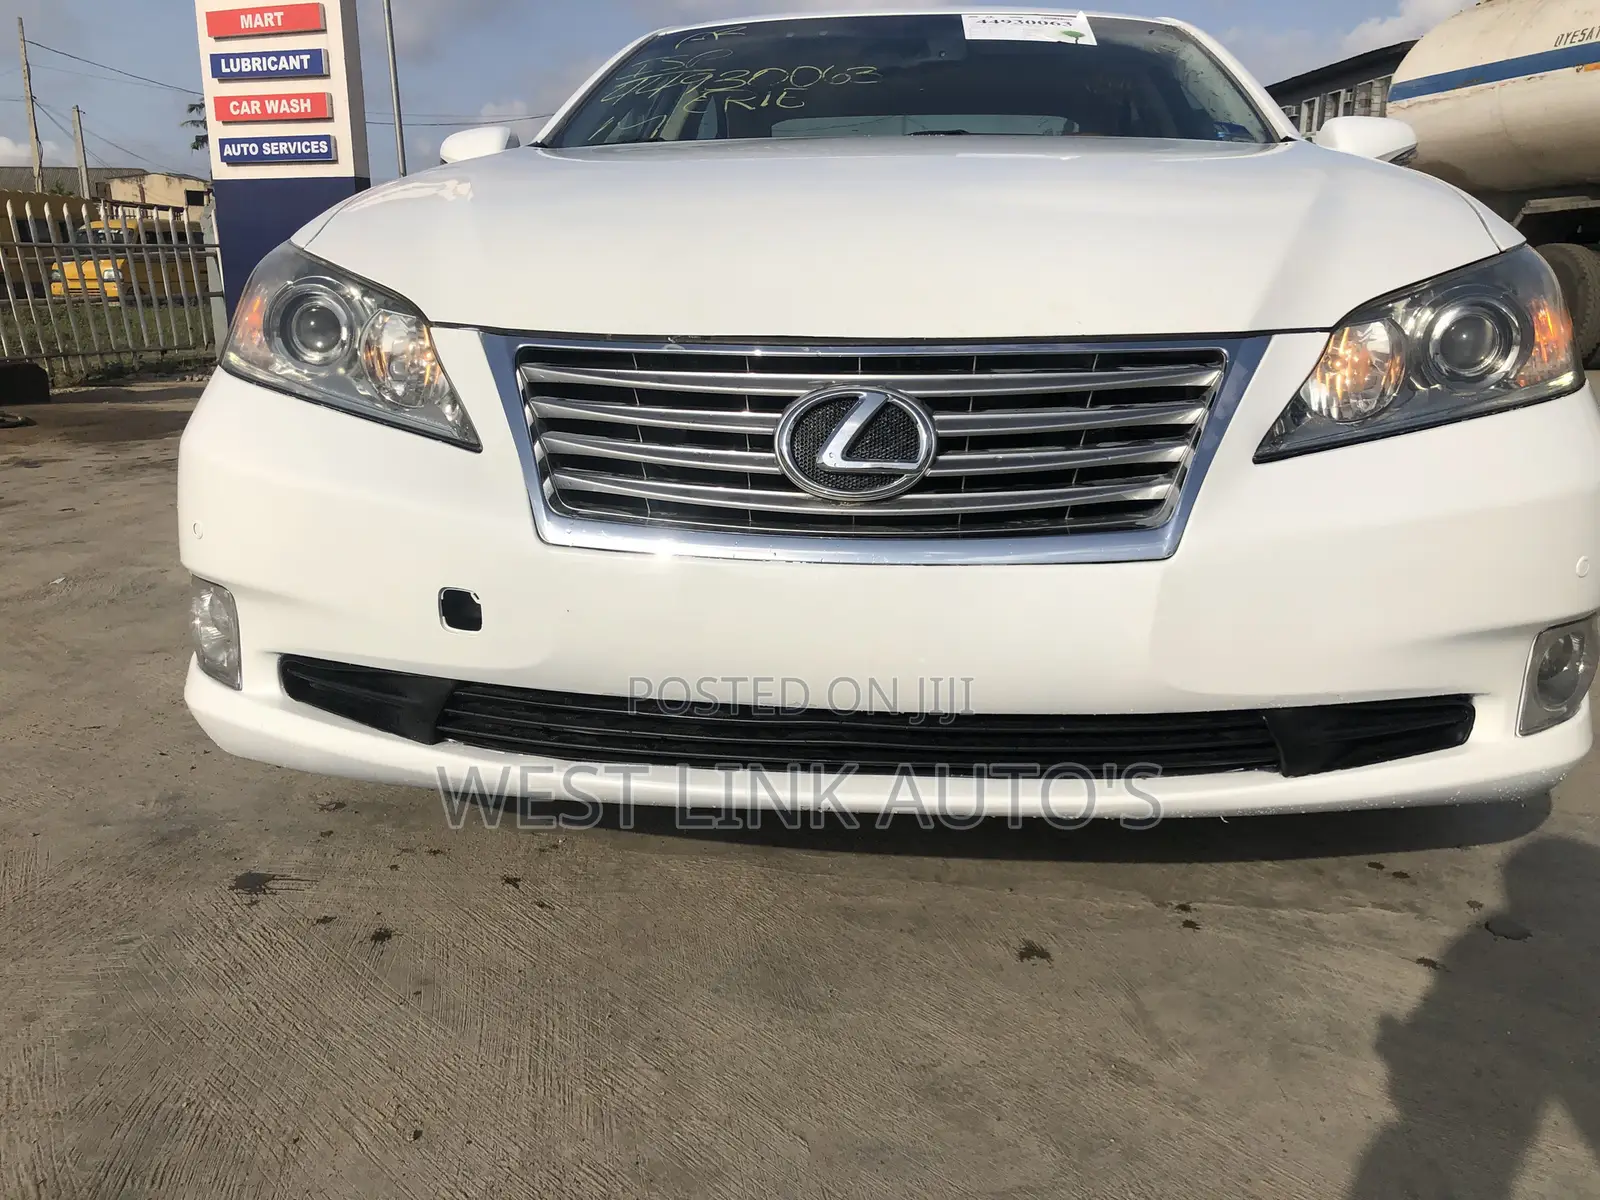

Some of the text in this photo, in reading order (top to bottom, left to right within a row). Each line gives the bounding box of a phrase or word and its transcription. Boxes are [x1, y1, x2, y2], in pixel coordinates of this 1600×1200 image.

[239, 11, 284, 29] MART
[975, 18, 1073, 28] 44930063
[220, 54, 311, 73] LUBRICANT
[229, 98, 312, 115] CAR WASH
[223, 140, 328, 157] AUTO SERVICES
